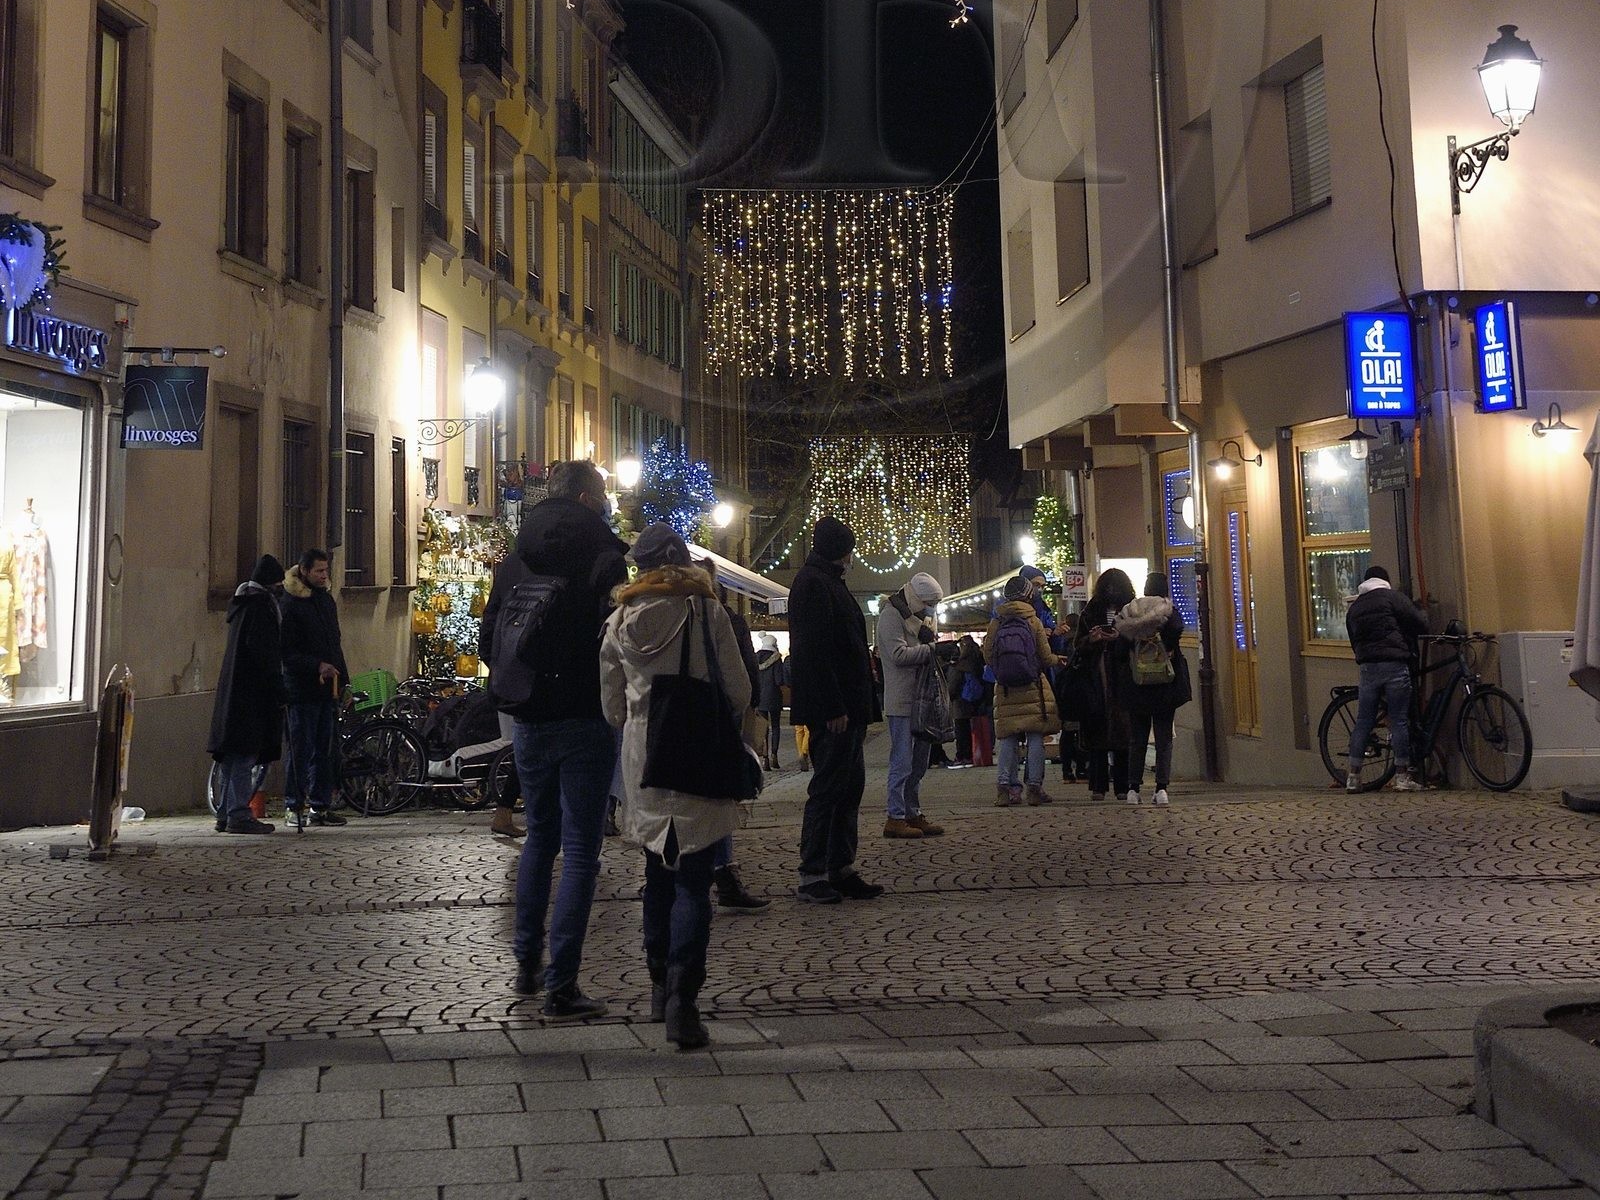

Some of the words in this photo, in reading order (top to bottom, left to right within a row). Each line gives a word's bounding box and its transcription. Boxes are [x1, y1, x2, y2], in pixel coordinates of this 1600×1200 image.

[1361, 359, 1403, 384] OLA!
[1484, 350, 1506, 379] OLA!
[124, 425, 198, 446] linvosges
